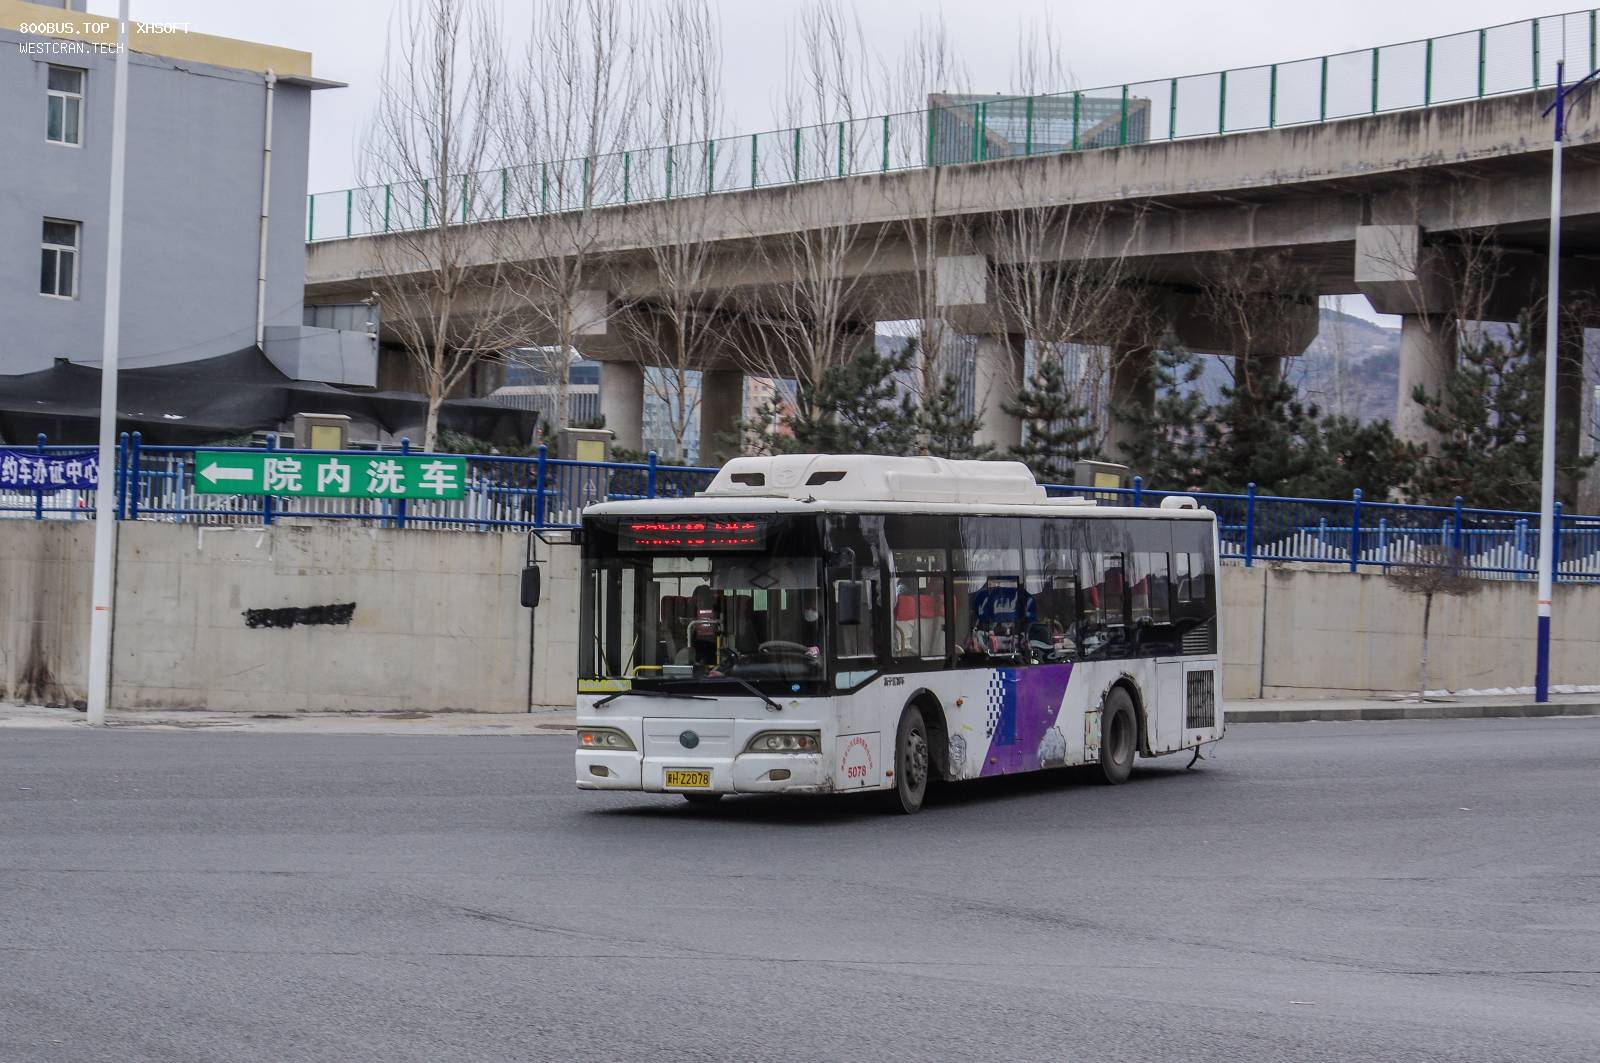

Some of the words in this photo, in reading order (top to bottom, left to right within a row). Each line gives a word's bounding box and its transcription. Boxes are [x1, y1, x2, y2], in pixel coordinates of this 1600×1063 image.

[262, 456, 459, 495] 院内洗车
[847, 764, 867, 779] 5078
